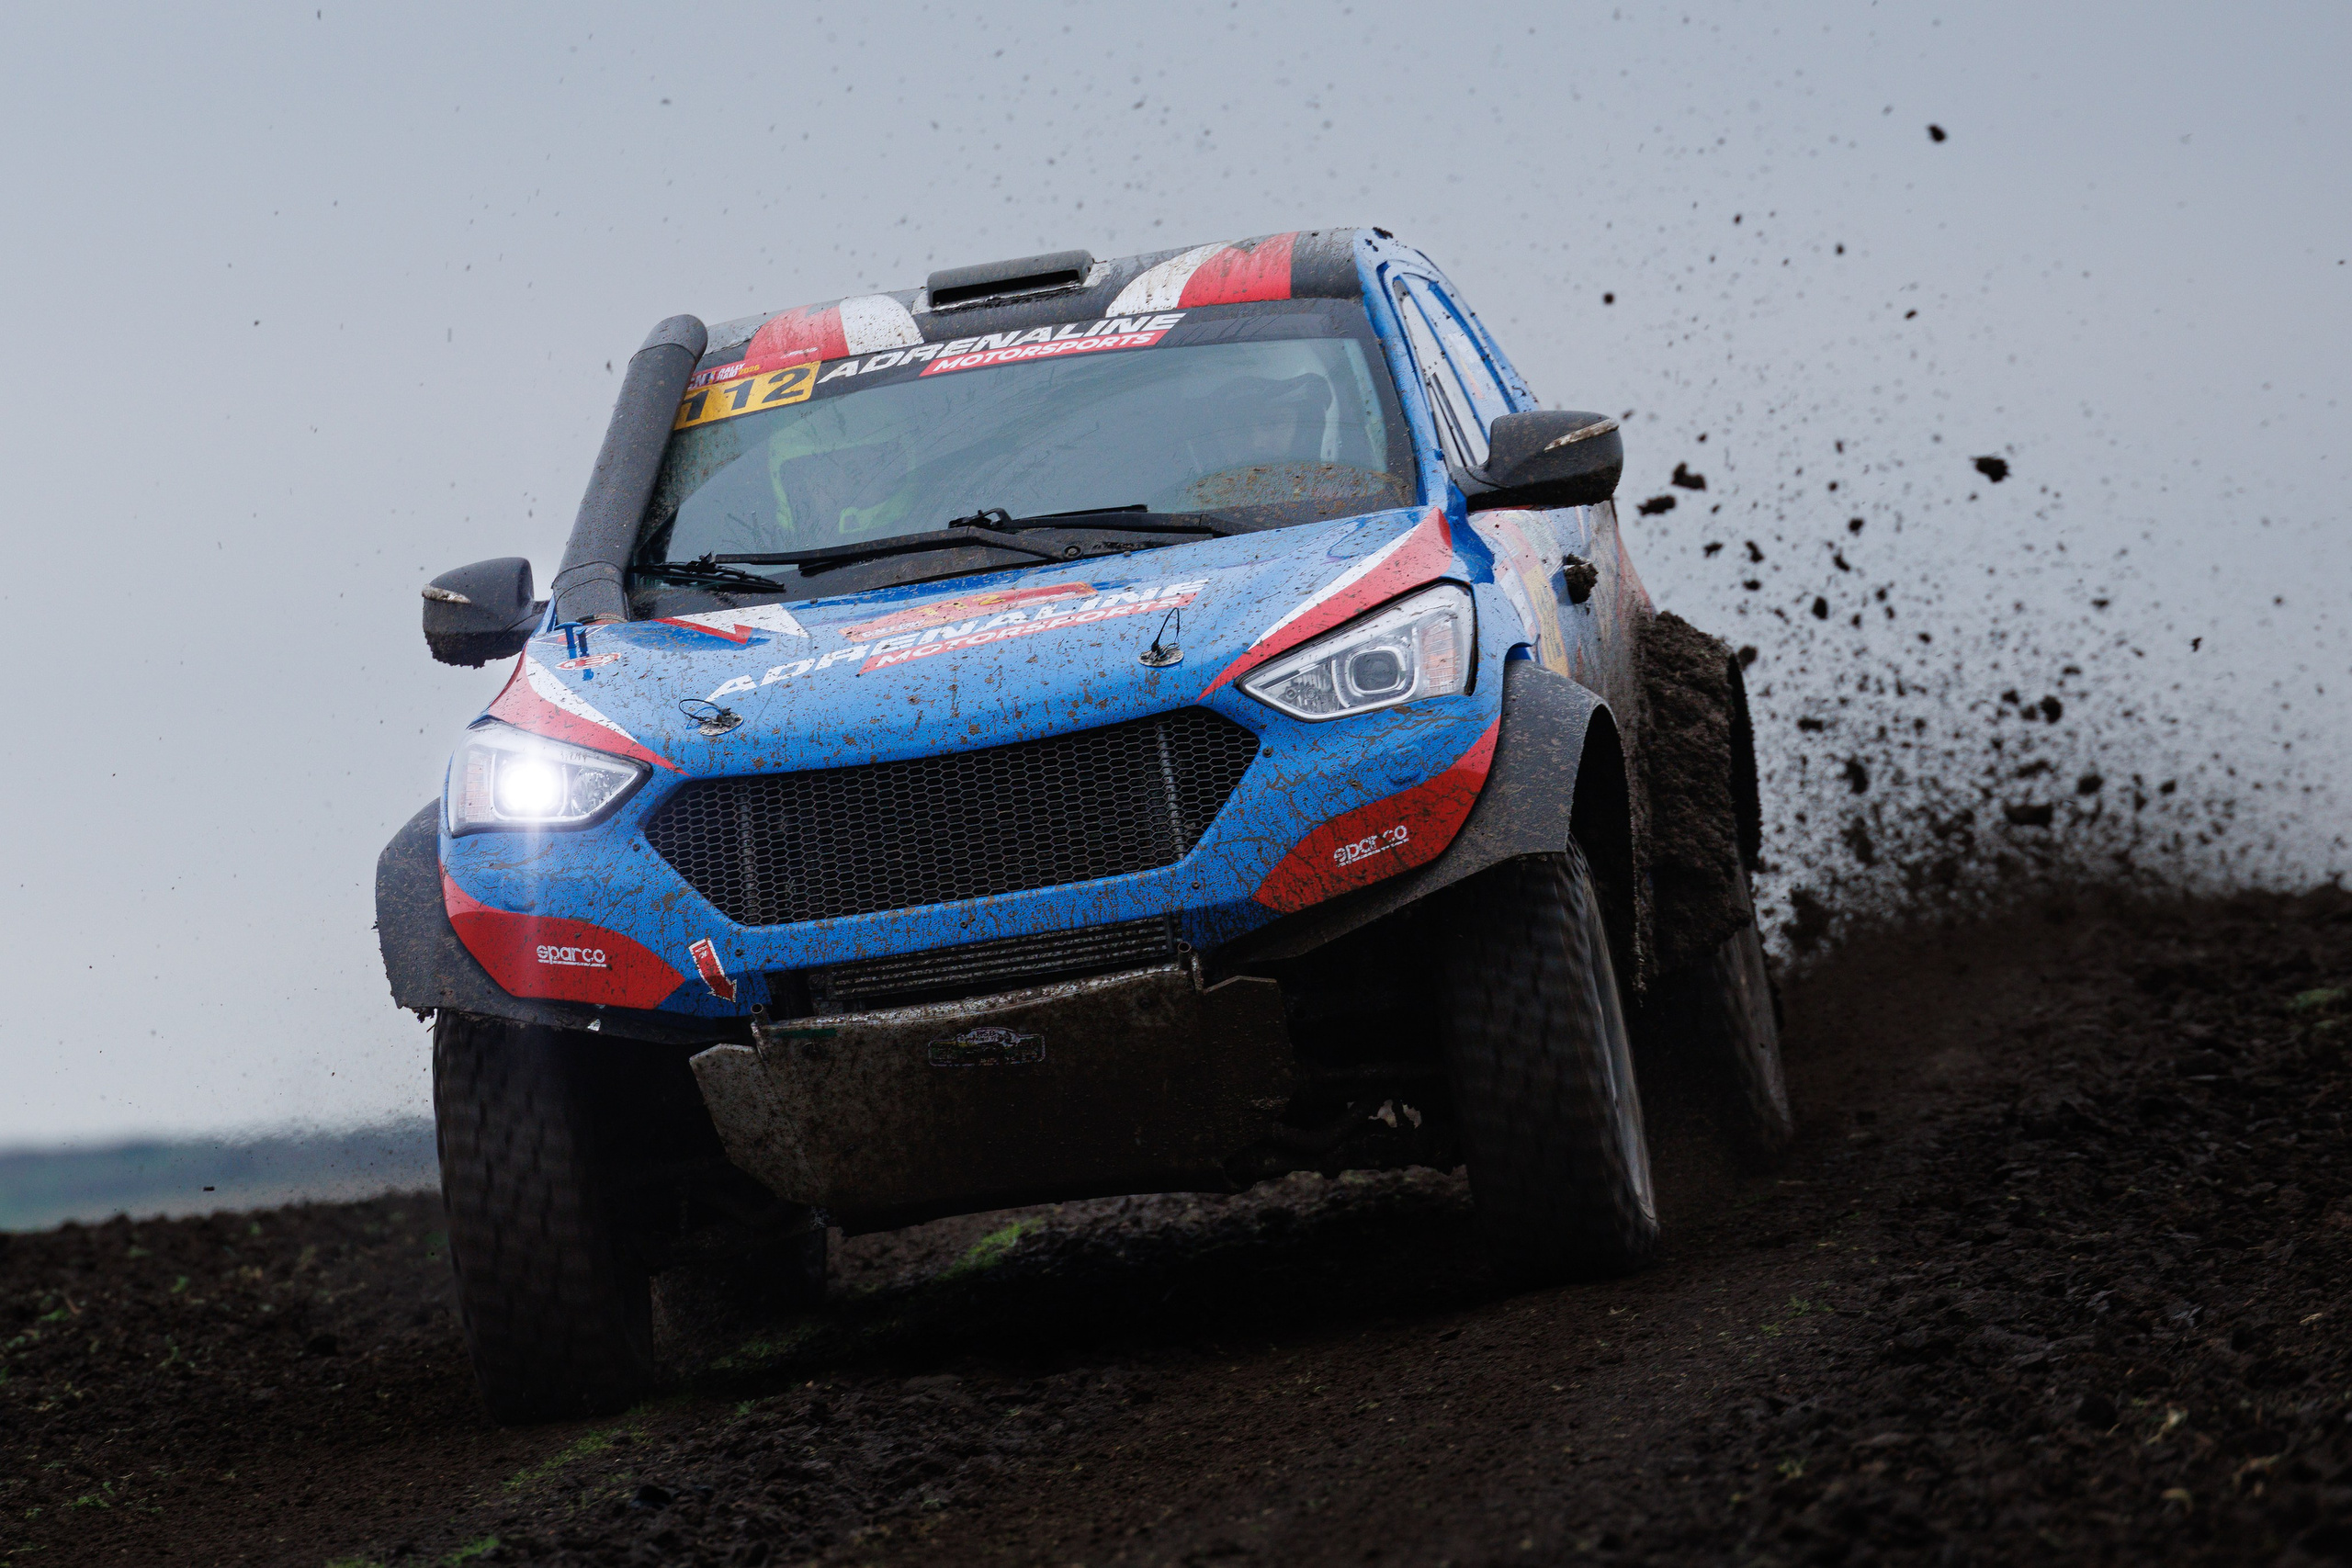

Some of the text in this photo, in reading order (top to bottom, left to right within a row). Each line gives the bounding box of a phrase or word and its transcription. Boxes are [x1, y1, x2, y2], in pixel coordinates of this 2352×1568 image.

[719, 362, 746, 375] RALLY
[816, 312, 1187, 385] ADRENALINE
[933, 333, 1156, 373] MOTORSPORTS
[682, 367, 810, 423] 112
[700, 578, 1210, 705] ADRENALINE
[876, 596, 1183, 668] MOTORSPORTS
[1333, 825, 1408, 865] sparco
[536, 944, 606, 964] sparco
